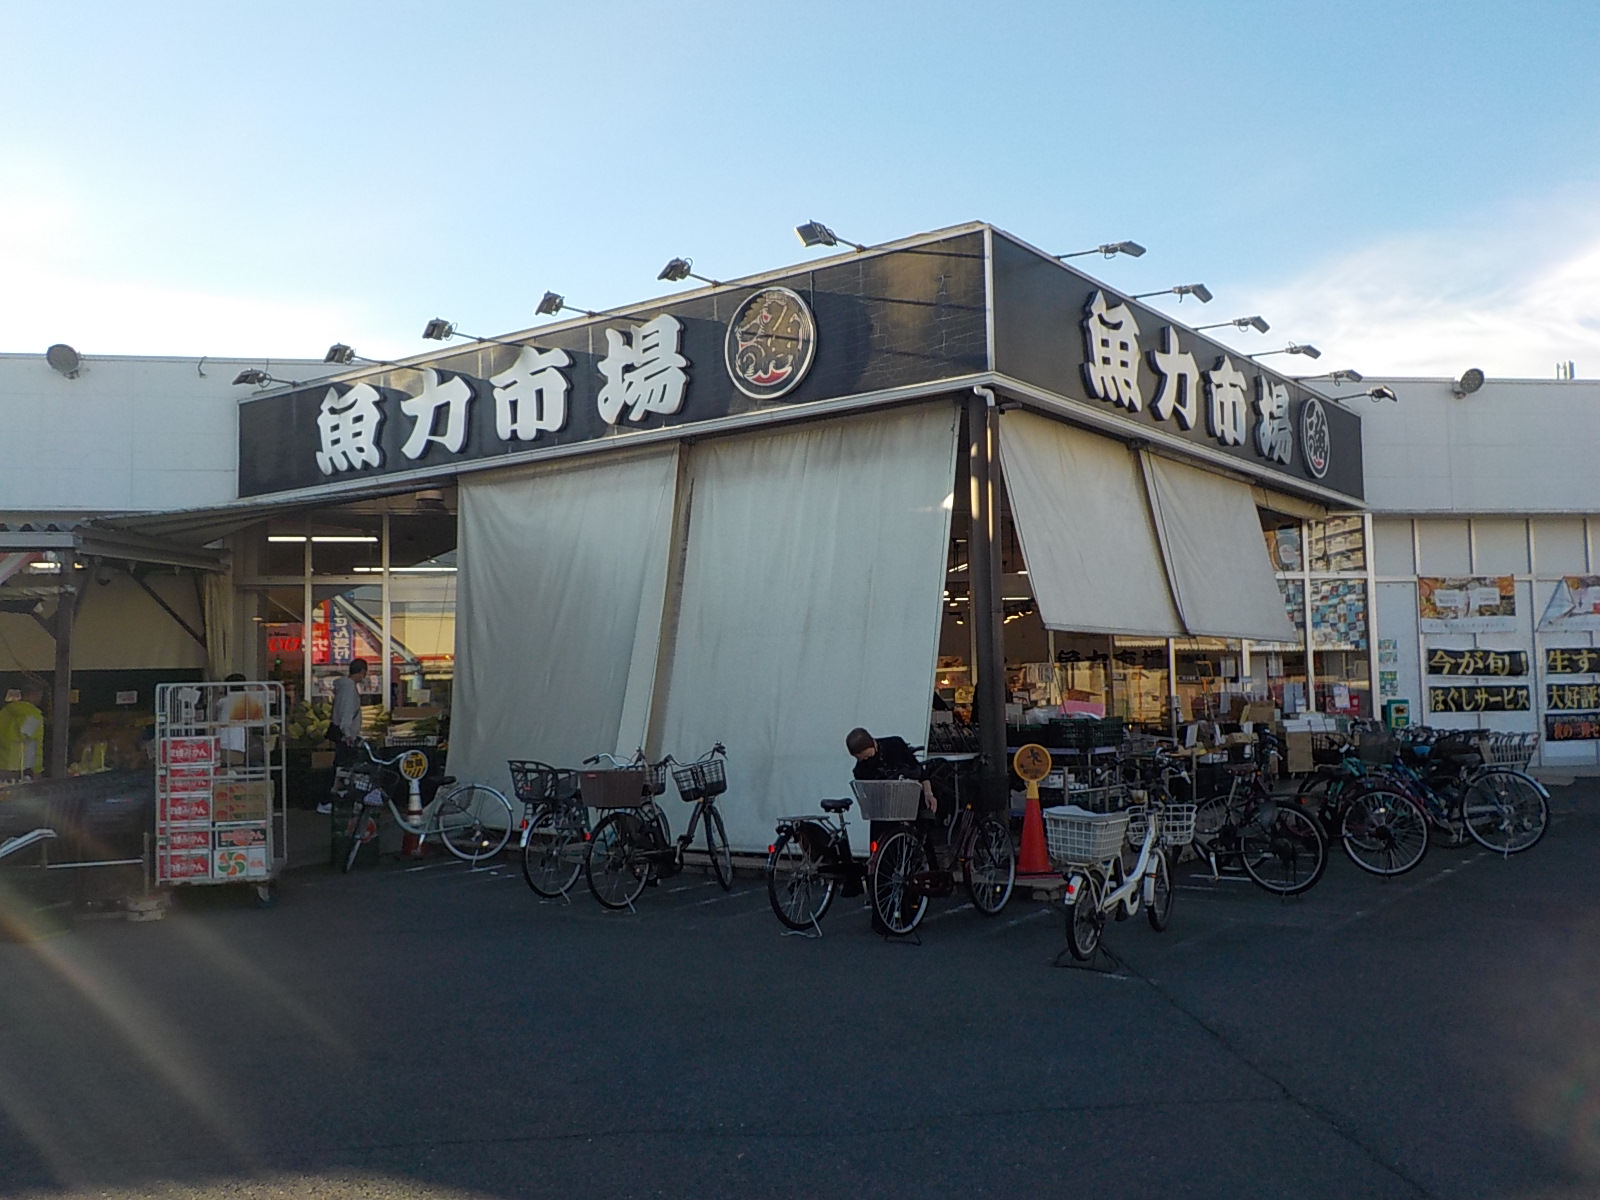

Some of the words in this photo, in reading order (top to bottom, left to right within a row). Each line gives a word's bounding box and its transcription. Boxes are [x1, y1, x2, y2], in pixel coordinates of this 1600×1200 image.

[1080, 289, 1292, 465] 魚力市場
[316, 313, 690, 475] 魚力市場
[1429, 650, 1528, 676] 今が旬！
[1547, 650, 1598, 674] 生す
[1430, 687, 1530, 712] ほぐしサービス
[1548, 685, 1600, 710] 大好評
